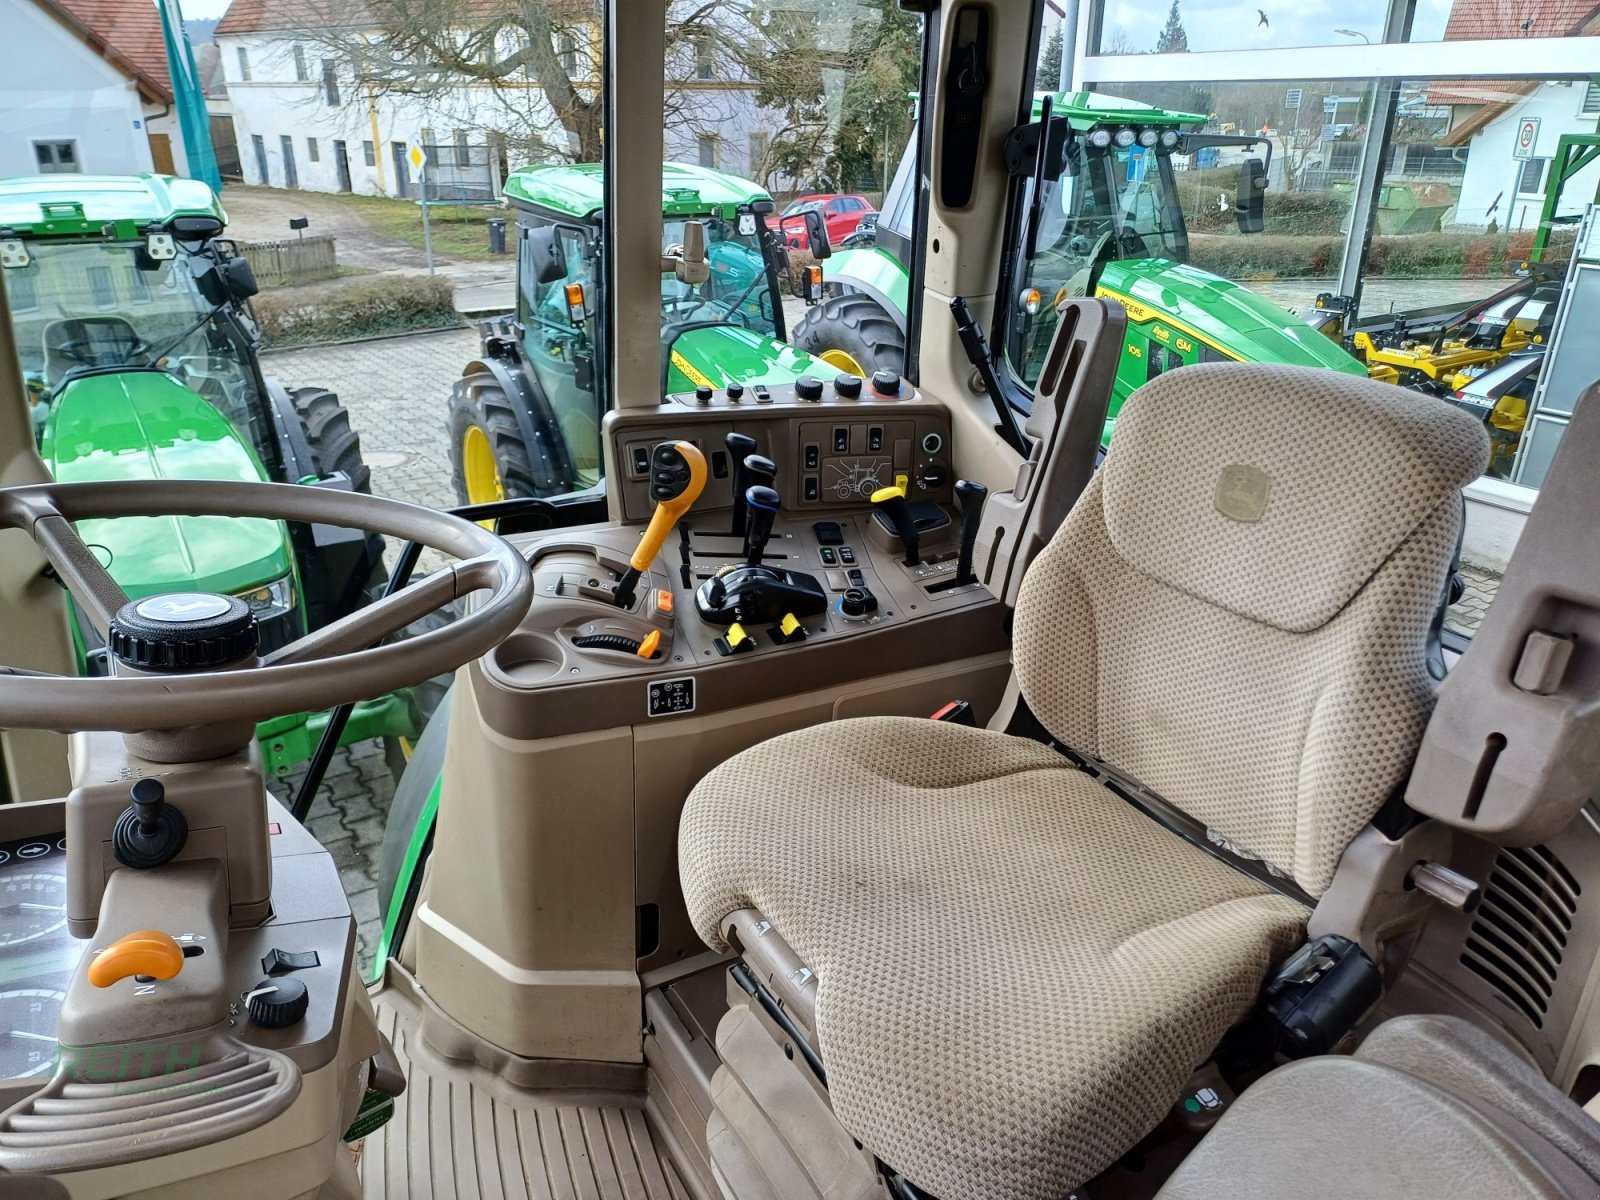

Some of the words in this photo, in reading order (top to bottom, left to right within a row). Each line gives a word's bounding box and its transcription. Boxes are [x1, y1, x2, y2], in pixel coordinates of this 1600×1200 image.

[1127, 343, 1142, 358] 105
[1175, 338, 1192, 353] 6M
[133, 984, 156, 996] N
